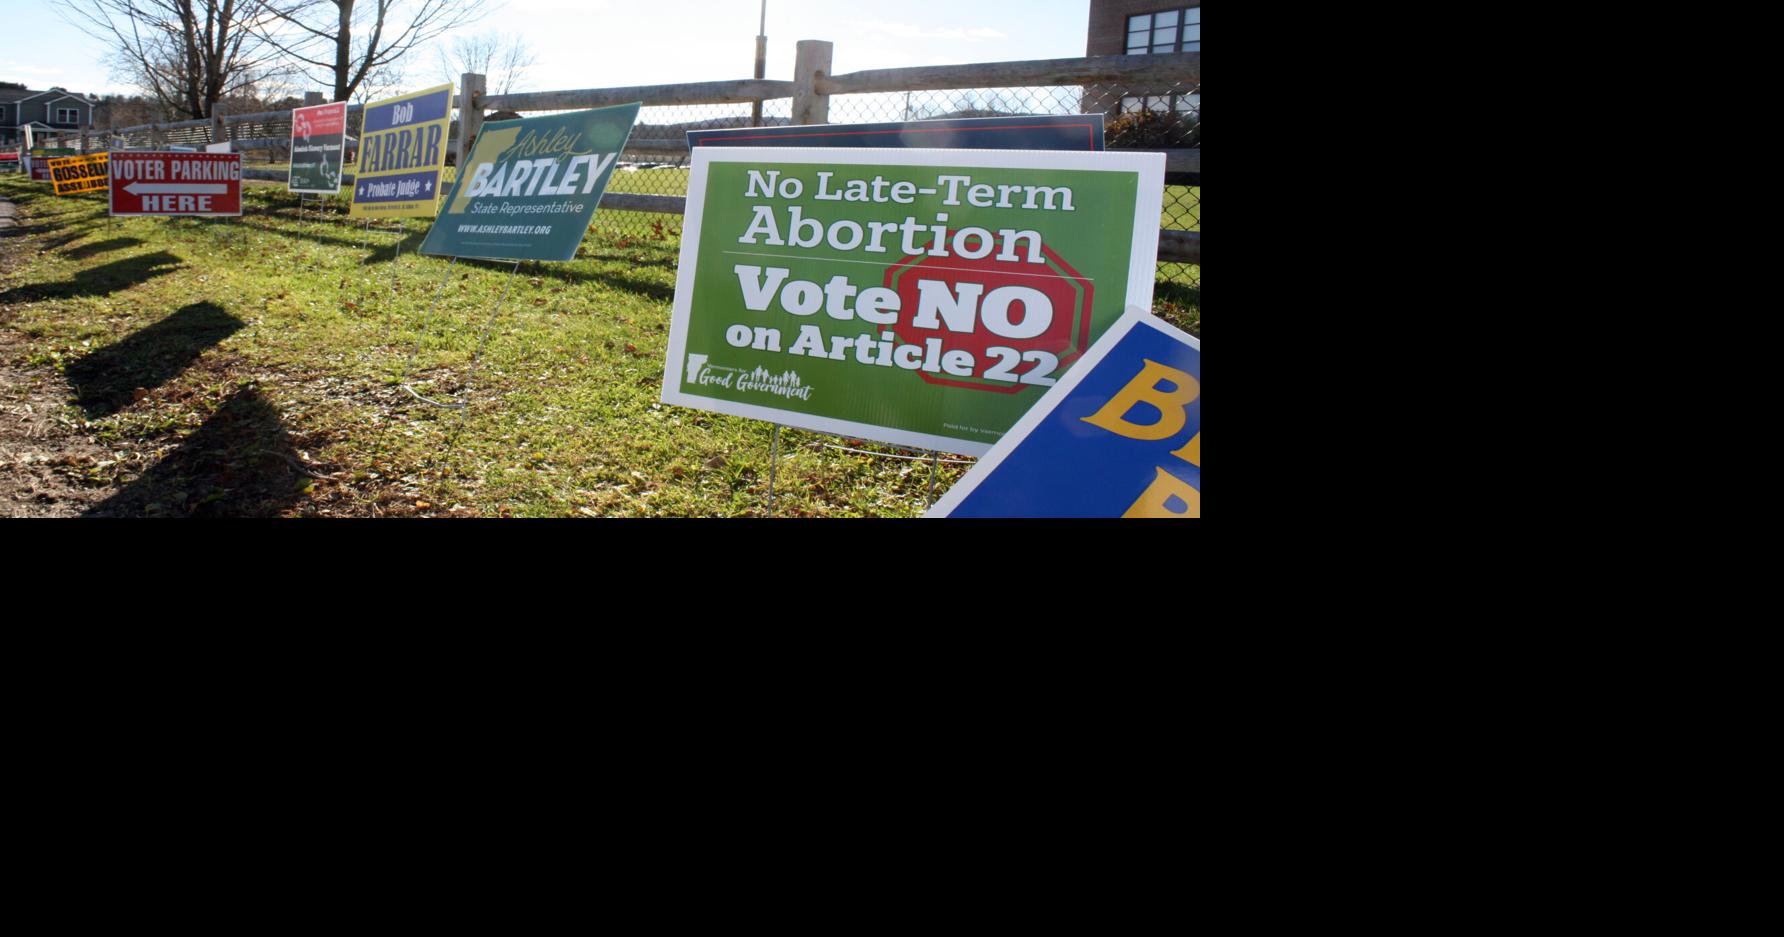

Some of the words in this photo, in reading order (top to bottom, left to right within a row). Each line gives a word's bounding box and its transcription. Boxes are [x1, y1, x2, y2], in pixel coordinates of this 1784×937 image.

[392, 102, 414, 126] Bob
[359, 124, 442, 173] FARRAR
[501, 126, 592, 163] Ashley
[112, 160, 164, 180] VOTER
[171, 160, 239, 180] PARKING
[464, 152, 617, 198] BARTLEY
[142, 195, 212, 211] HERE
[367, 181, 396, 197] Probate
[396, 179, 420, 197] Judge
[744, 169, 803, 199] No
[814, 171, 1075, 212] Late-Term
[471, 202, 498, 214] State
[500, 201, 584, 216] Representative
[457, 224, 552, 235] WWW.ASHLEYBARTLEY.ORG
[738, 205, 1046, 264] Abortion
[733, 264, 901, 325] Vote
[912, 279, 1054, 339] NO
[726, 324, 781, 352] on
[789, 325, 976, 377] Article
[983, 346, 1059, 387] 22
[700, 367, 734, 389] Good
[736, 372, 814, 401] Government
